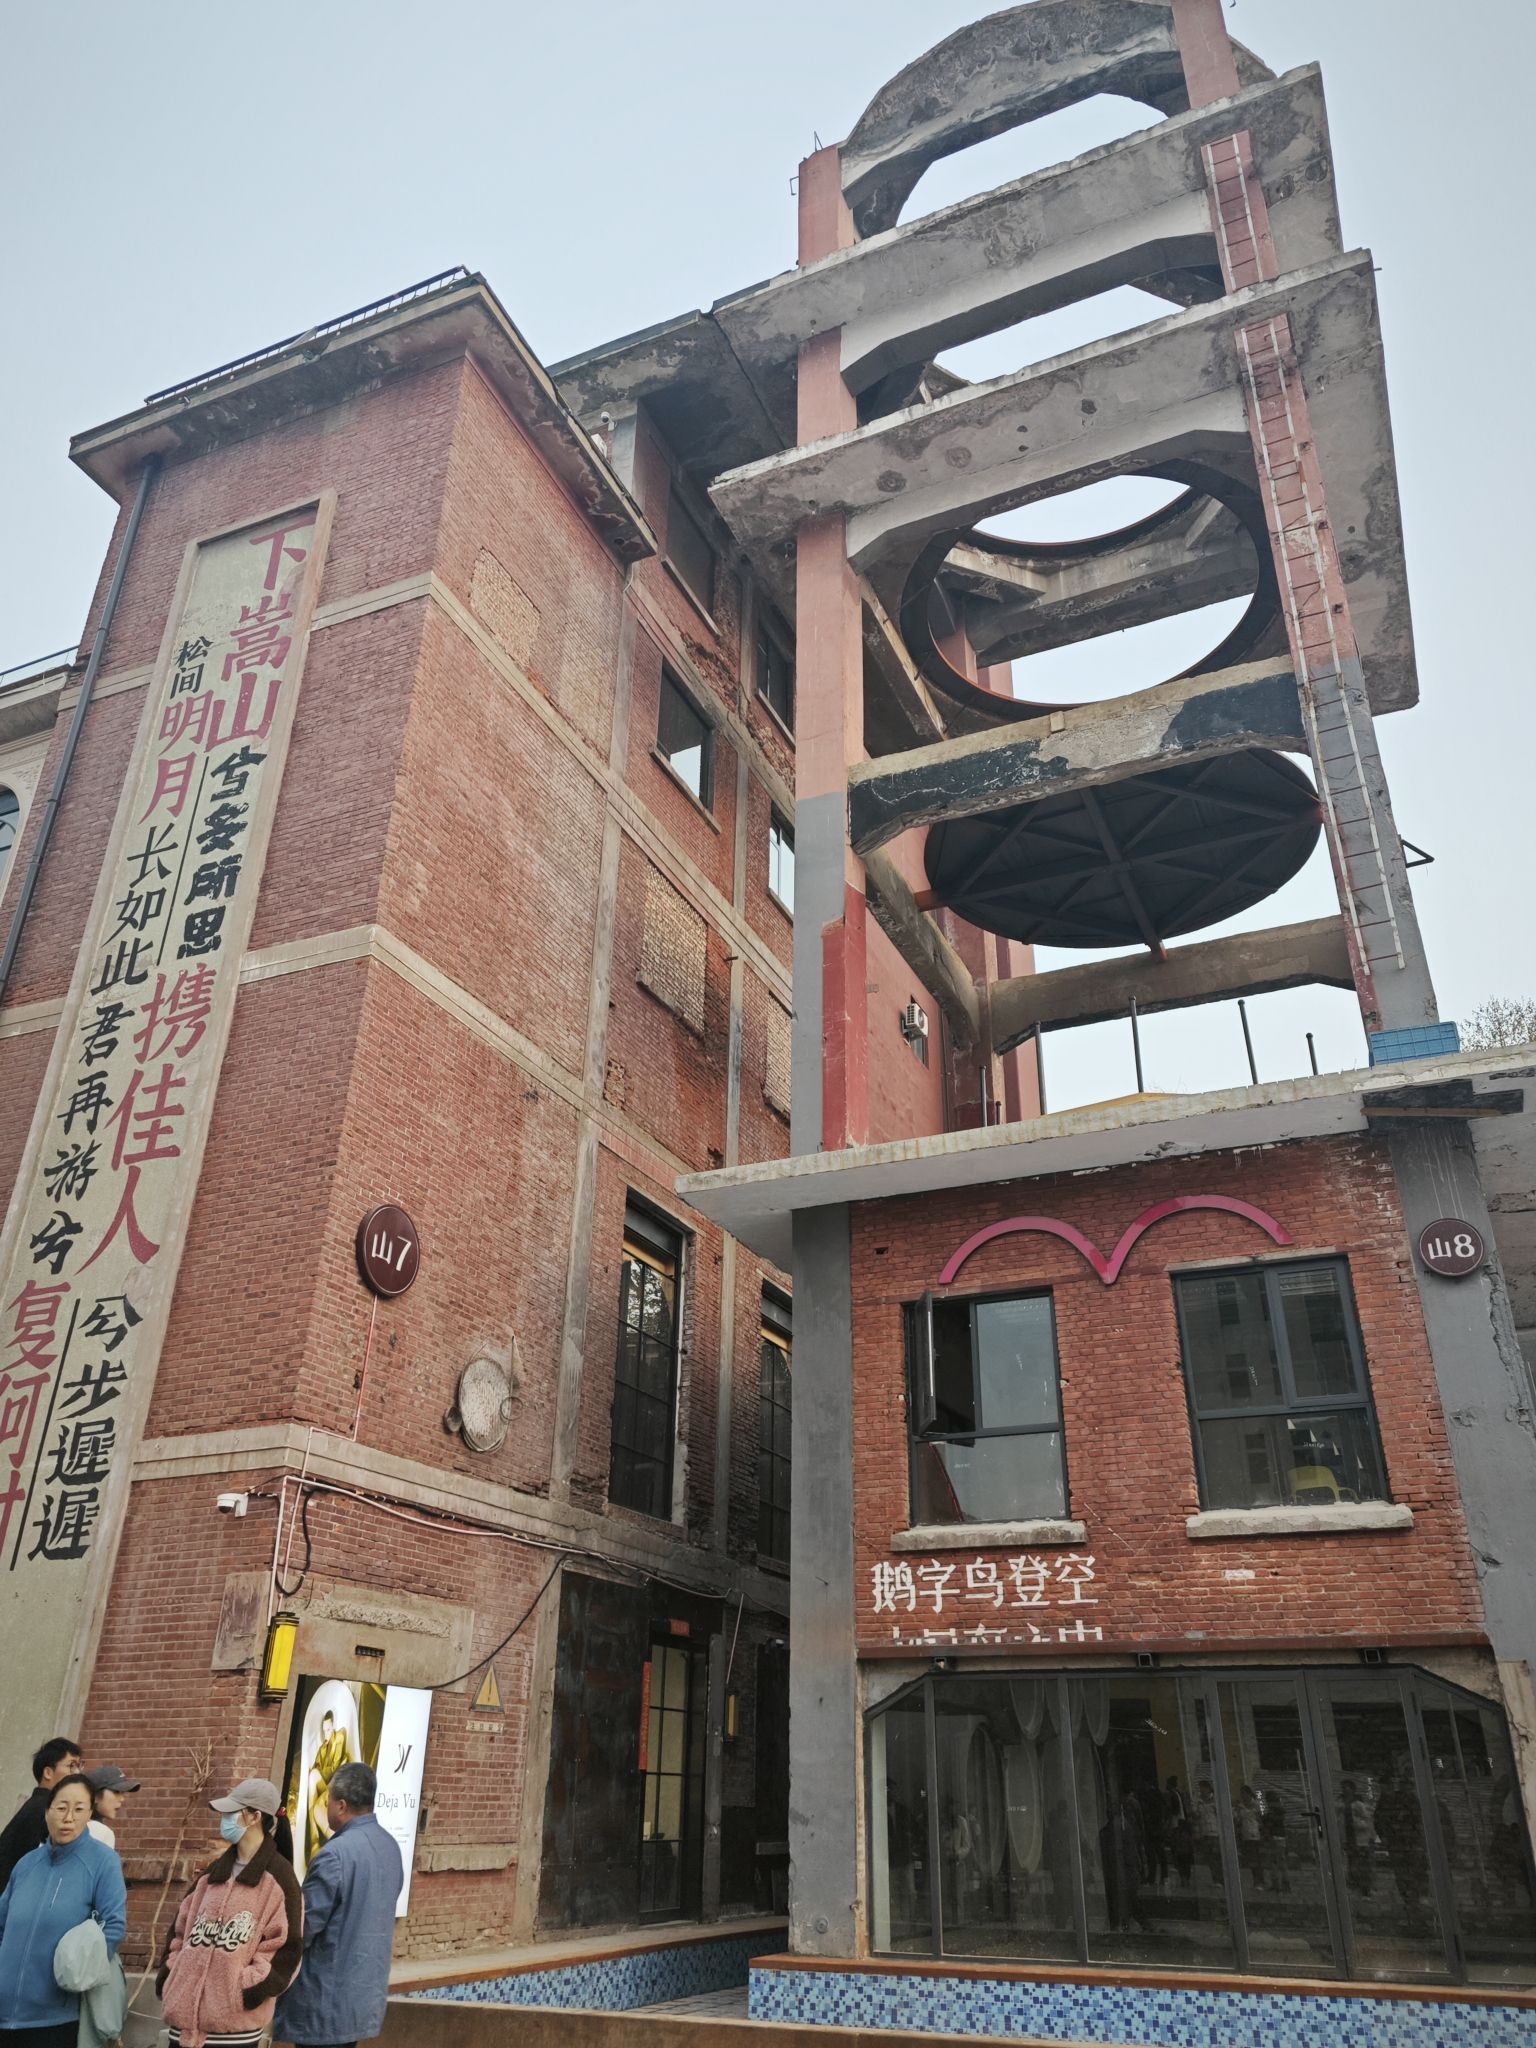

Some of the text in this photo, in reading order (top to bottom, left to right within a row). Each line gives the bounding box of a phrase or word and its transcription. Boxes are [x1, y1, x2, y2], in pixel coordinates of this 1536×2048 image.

[870, 1553, 1099, 1614] 鹅字鸟登空
